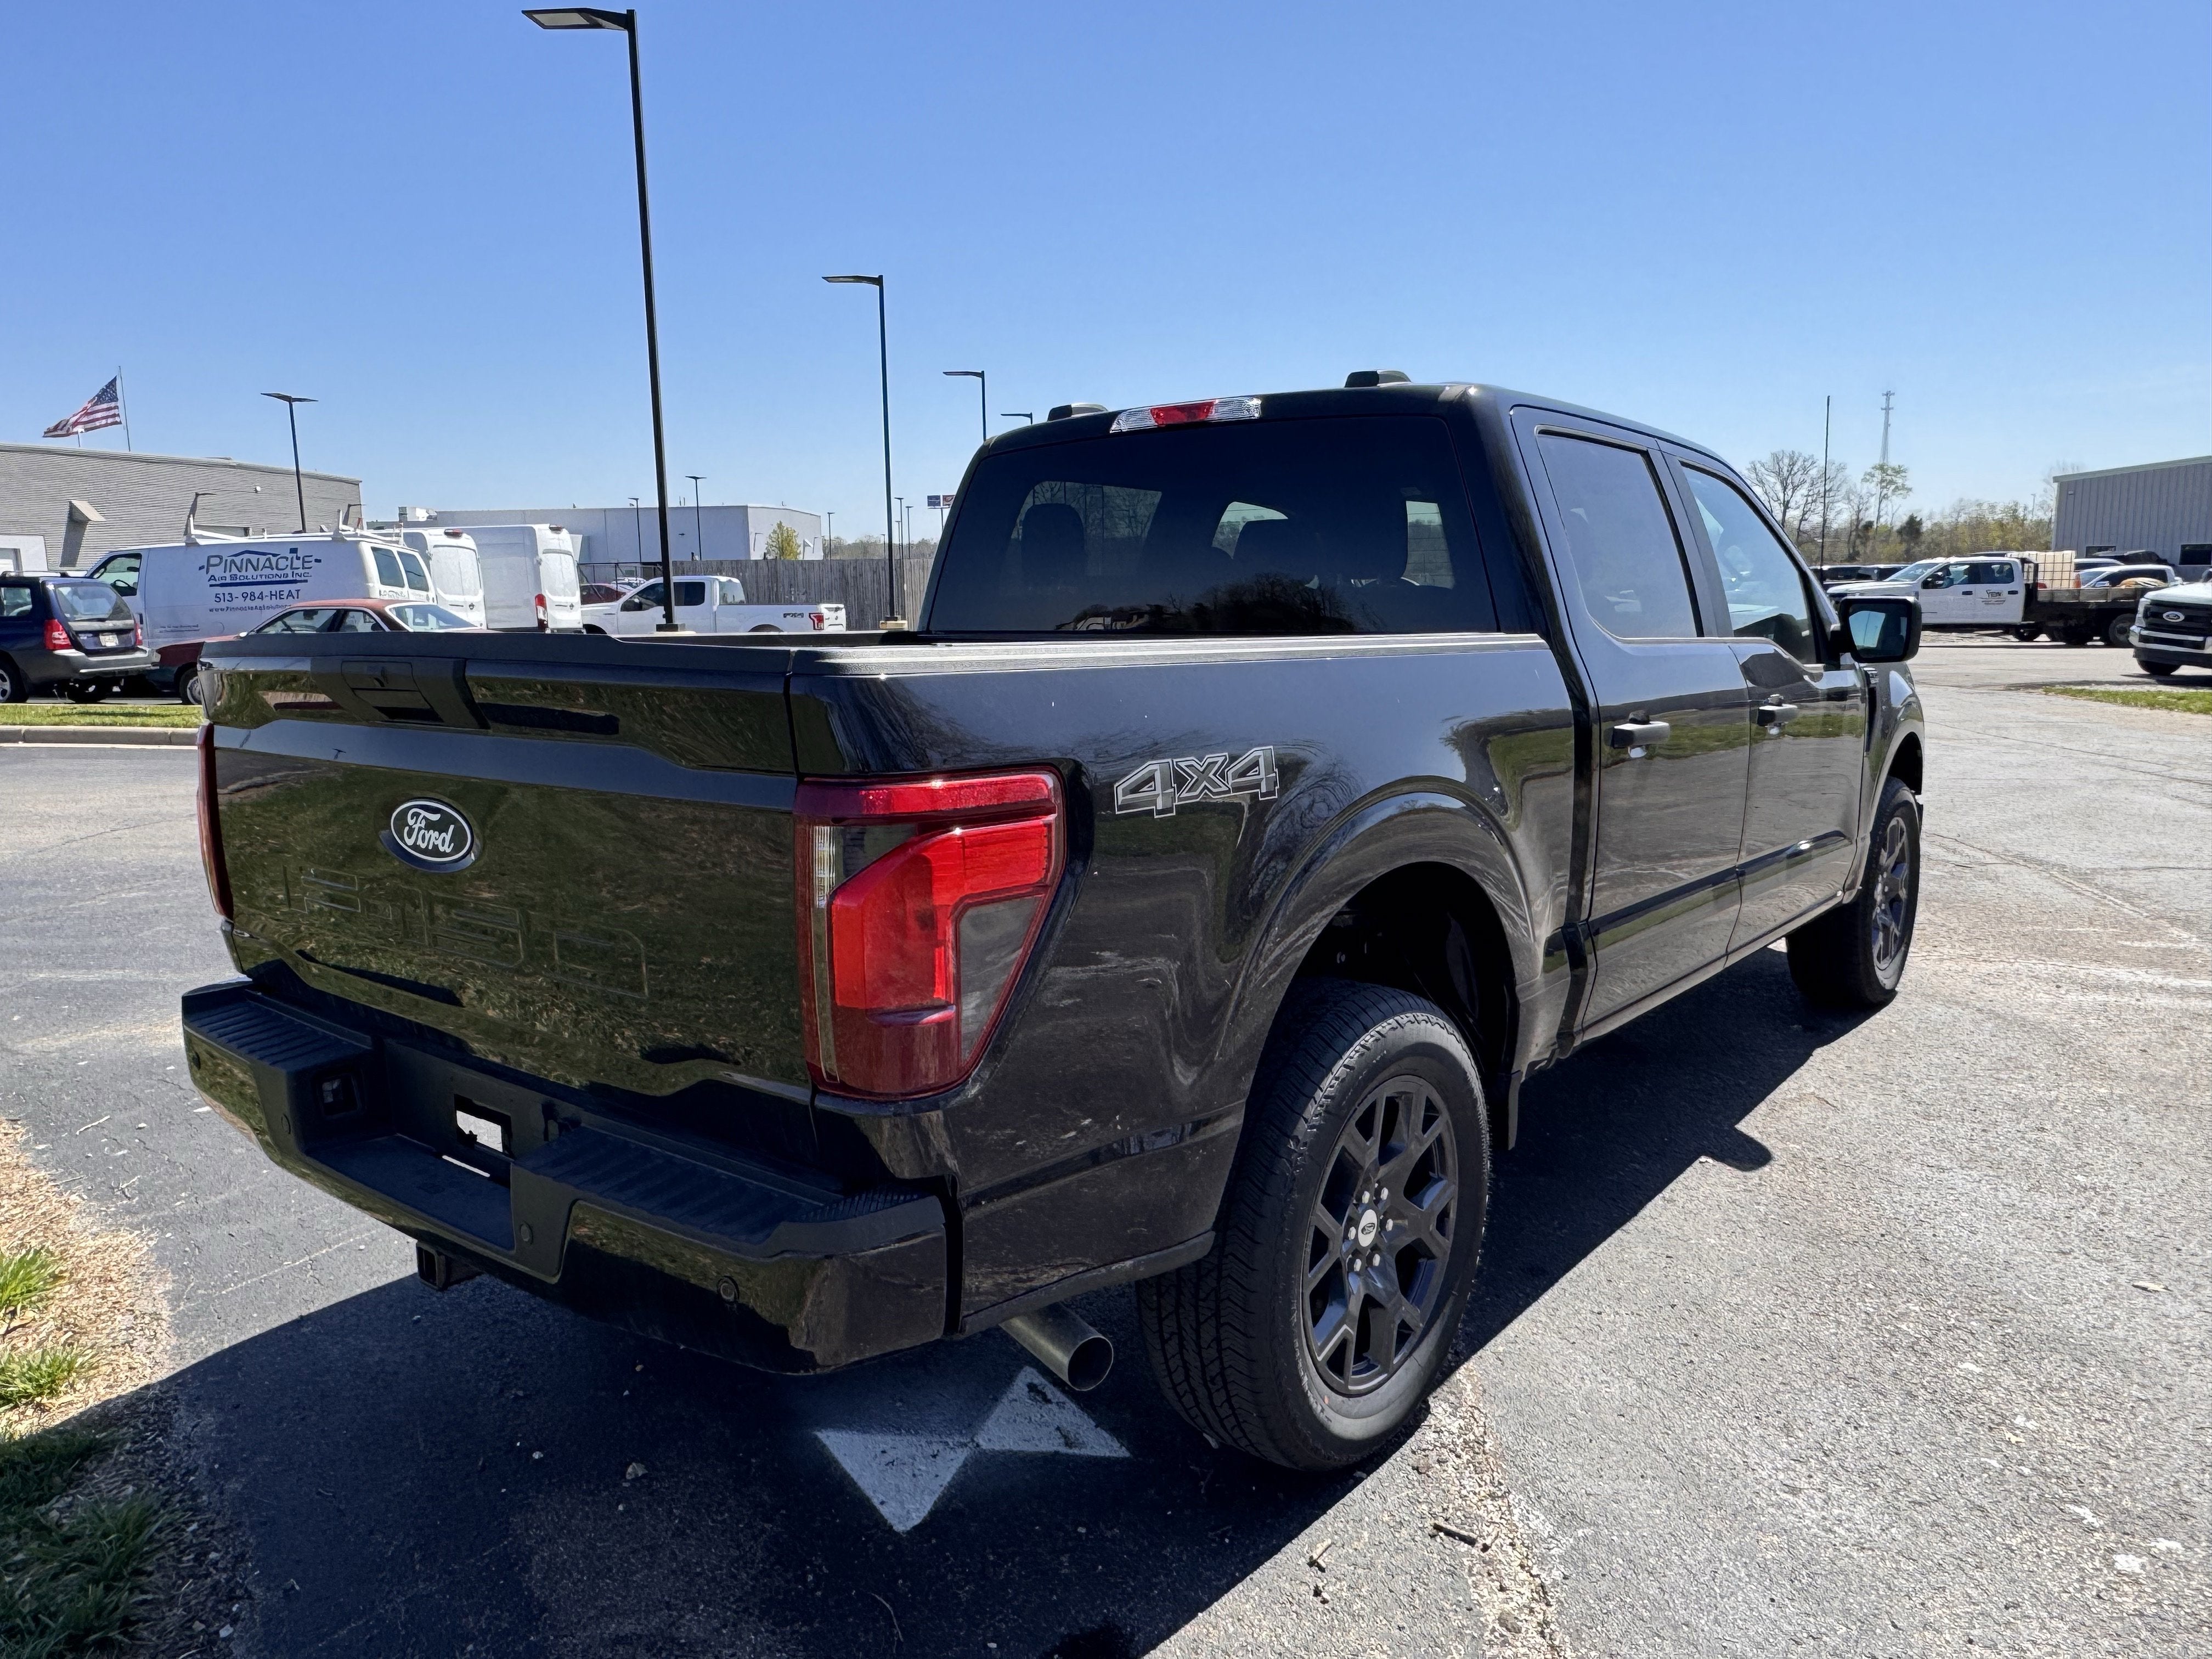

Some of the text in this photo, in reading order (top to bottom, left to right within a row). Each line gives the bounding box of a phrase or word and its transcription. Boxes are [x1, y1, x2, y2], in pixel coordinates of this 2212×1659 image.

[206, 554, 313, 574] PINNACLE
[214, 589, 301, 603] 513-984-HEAT
[403, 808, 455, 853] Ford
